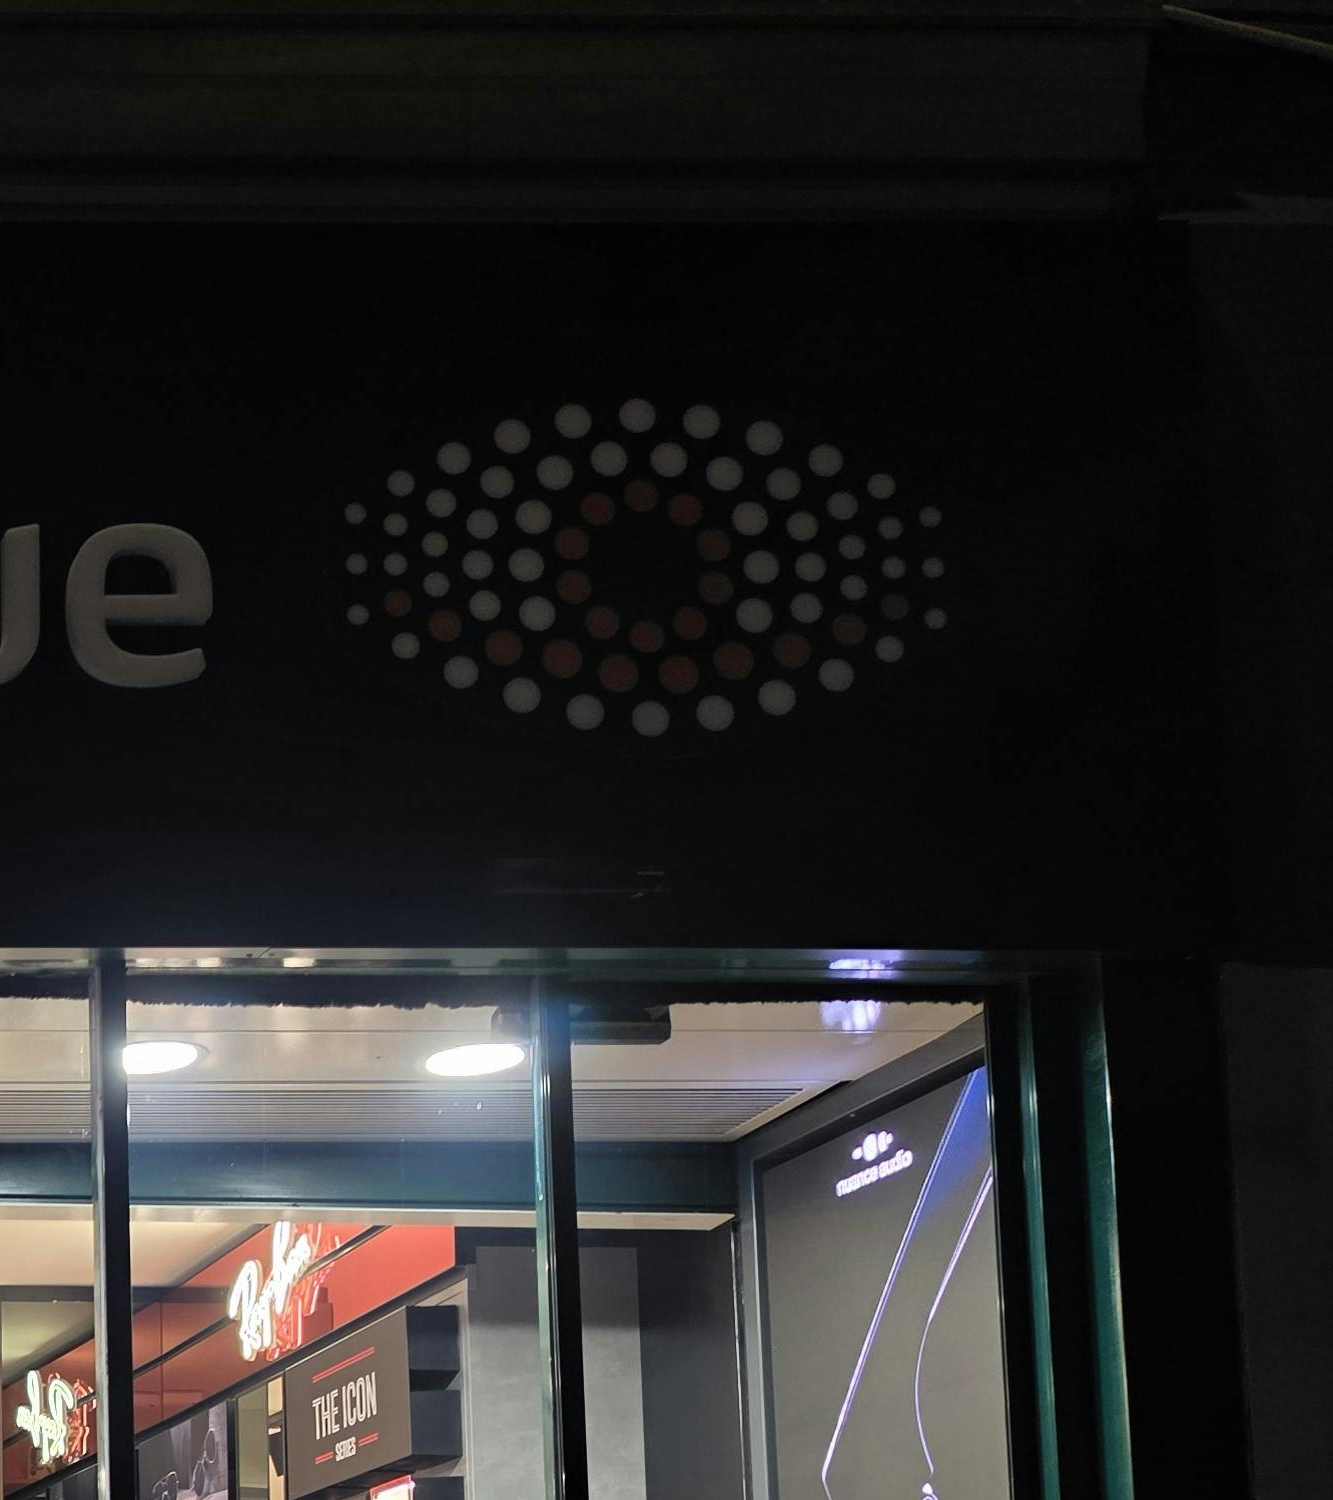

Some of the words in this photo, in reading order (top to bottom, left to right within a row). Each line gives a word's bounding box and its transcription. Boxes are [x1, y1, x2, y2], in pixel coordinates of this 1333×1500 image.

[835, 1160, 880, 1197] nuance
[878, 1147, 914, 1180] audio
[312, 1389, 340, 1440] THE
[342, 1371, 377, 1428] ICON
[335, 1437, 356, 1461] SERIES
